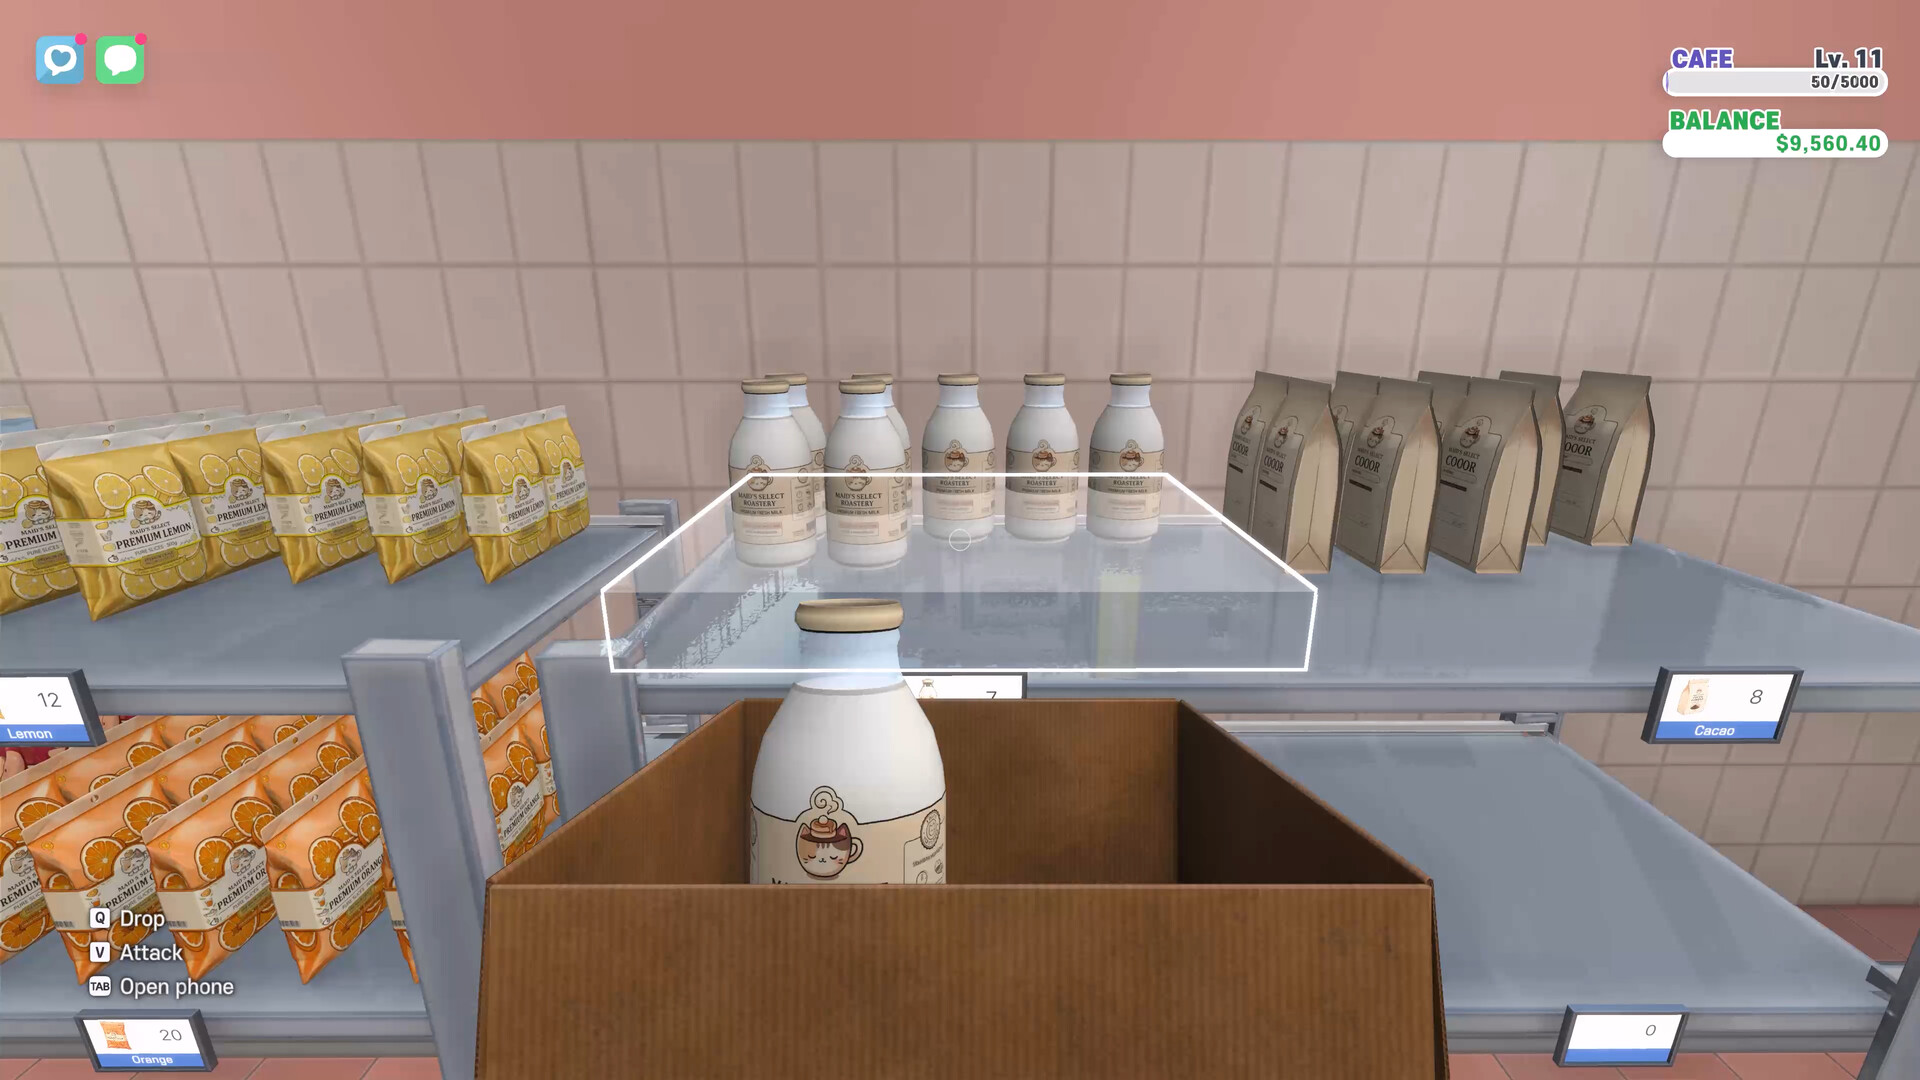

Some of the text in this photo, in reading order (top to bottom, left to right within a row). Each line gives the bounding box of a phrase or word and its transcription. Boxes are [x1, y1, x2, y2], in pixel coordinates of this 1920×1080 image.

[1355, 455, 1380, 473] COOOR
[1446, 455, 1476, 473] COOOR
[738, 492, 785, 500] MAID'S SELECT
[217, 508, 253, 522] PREMIUM
[314, 507, 346, 522] PREMIUM
[411, 506, 438, 522] PREMIUM
[21, 526, 45, 536] MAID'S
[115, 521, 192, 550] PREMIUM LEMON
[129, 520, 171, 536] MAID'S SELECT
[5, 530, 57, 550] PREMIUM
[37, 692, 62, 708] 12
[1750, 689, 1763, 705] 8
[7, 727, 53, 740] Lemon
[1694, 724, 1736, 736] Cacao
[7, 876, 31, 892] MAID'S
[228, 875, 247, 892] MAID'S
[247, 860, 265, 877] SELECT
[118, 876, 139, 893] MAID'S
[105, 877, 149, 909] PREMIUM
[217, 877, 255, 911] PREMIUM
[329, 877, 362, 910] PREMIUM
[159, 1029, 183, 1041] 20
[1645, 1024, 1657, 1036] 0
[131, 1054, 174, 1066] Orange
